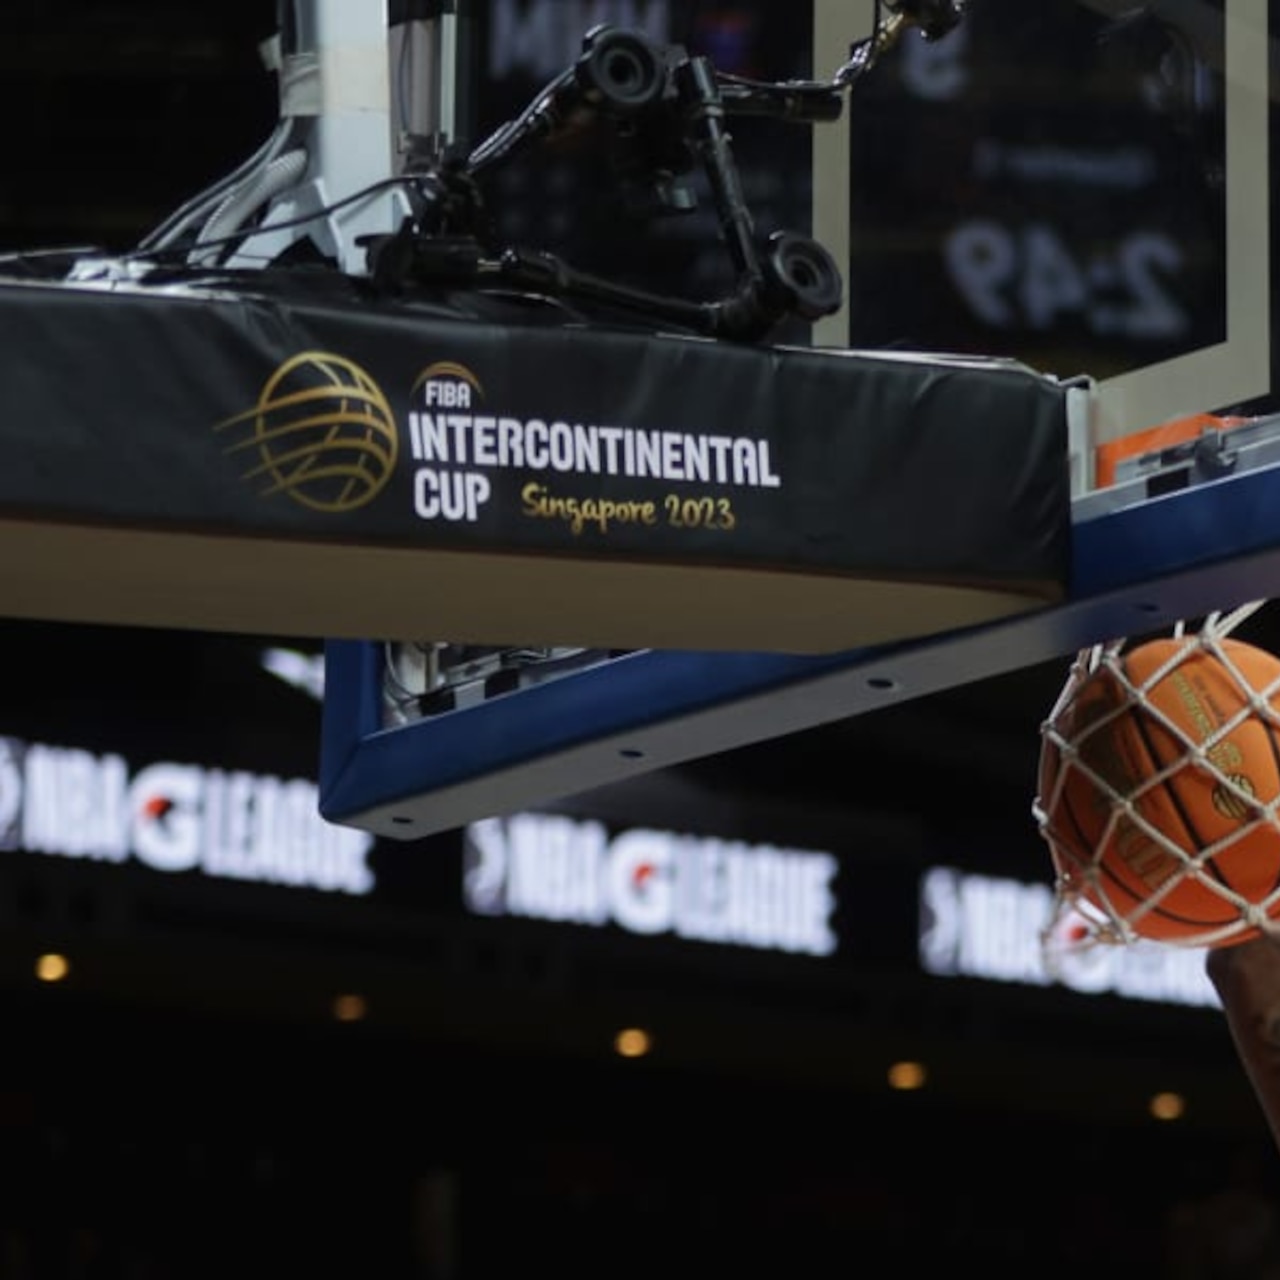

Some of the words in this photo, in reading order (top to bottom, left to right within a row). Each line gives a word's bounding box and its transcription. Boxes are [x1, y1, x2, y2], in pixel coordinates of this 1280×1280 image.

[425, 379, 471, 409] FIBA
[408, 412, 781, 488] INTERCONTINENTAL
[414, 468, 491, 521] CUP
[521, 481, 656, 536] Singapore
[663, 494, 736, 530] 2023
